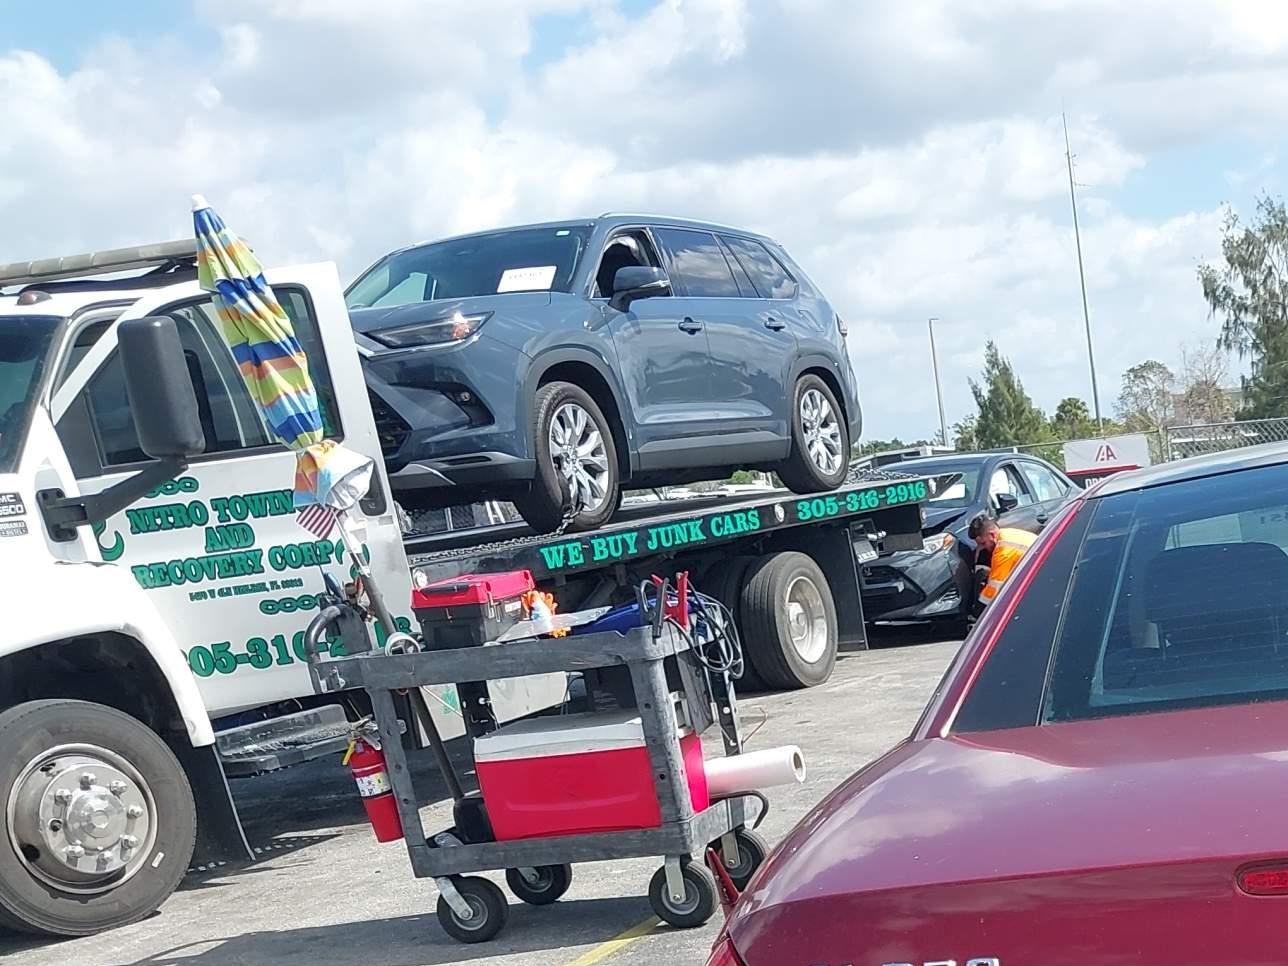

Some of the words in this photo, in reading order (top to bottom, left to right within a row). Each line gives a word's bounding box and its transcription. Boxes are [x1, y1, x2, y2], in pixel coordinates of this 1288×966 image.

[126, 500, 209, 535] NITRO
[210, 488, 300, 524] TOWIN
[797, 480, 926, 520] 305-316-2916
[204, 522, 256, 554] AND
[540, 543, 584, 569] WE
[591, 532, 638, 561] BUY
[647, 518, 706, 551] JUNK
[710, 508, 760, 537] CARS
[131, 548, 264, 590] RECOVERY
[267, 538, 335, 571] CORP
